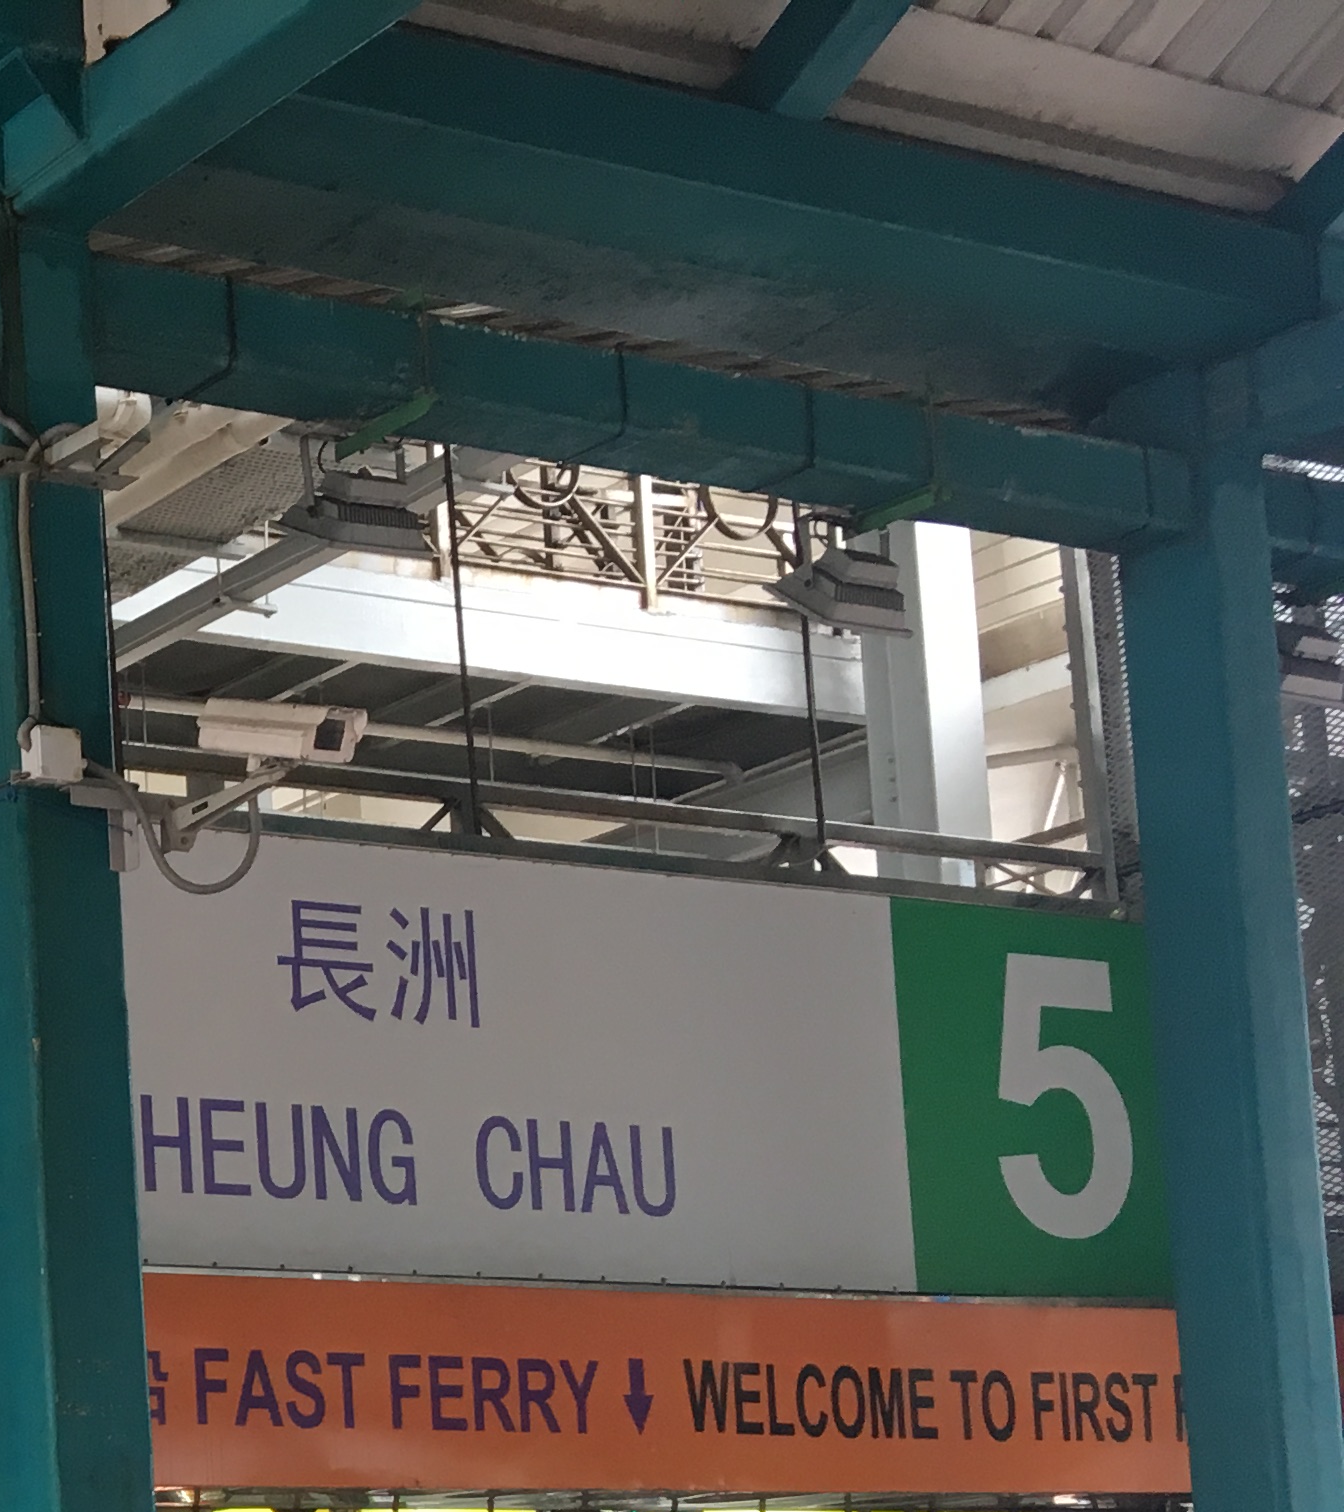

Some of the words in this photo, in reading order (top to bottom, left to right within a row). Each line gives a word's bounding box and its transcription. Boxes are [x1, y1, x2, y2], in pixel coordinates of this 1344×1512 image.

[278, 899, 482, 1030] 長洲
[139, 1093, 419, 1208] HEUNG
[475, 1116, 677, 1219] CHAU
[996, 953, 1134, 1241] 5
[194, 1348, 365, 1429] FAST
[387, 1353, 600, 1436] FERRY
[684, 1358, 939, 1441] WELCOME
[950, 1369, 1016, 1442] TO
[1030, 1371, 1159, 1443] FIRST
